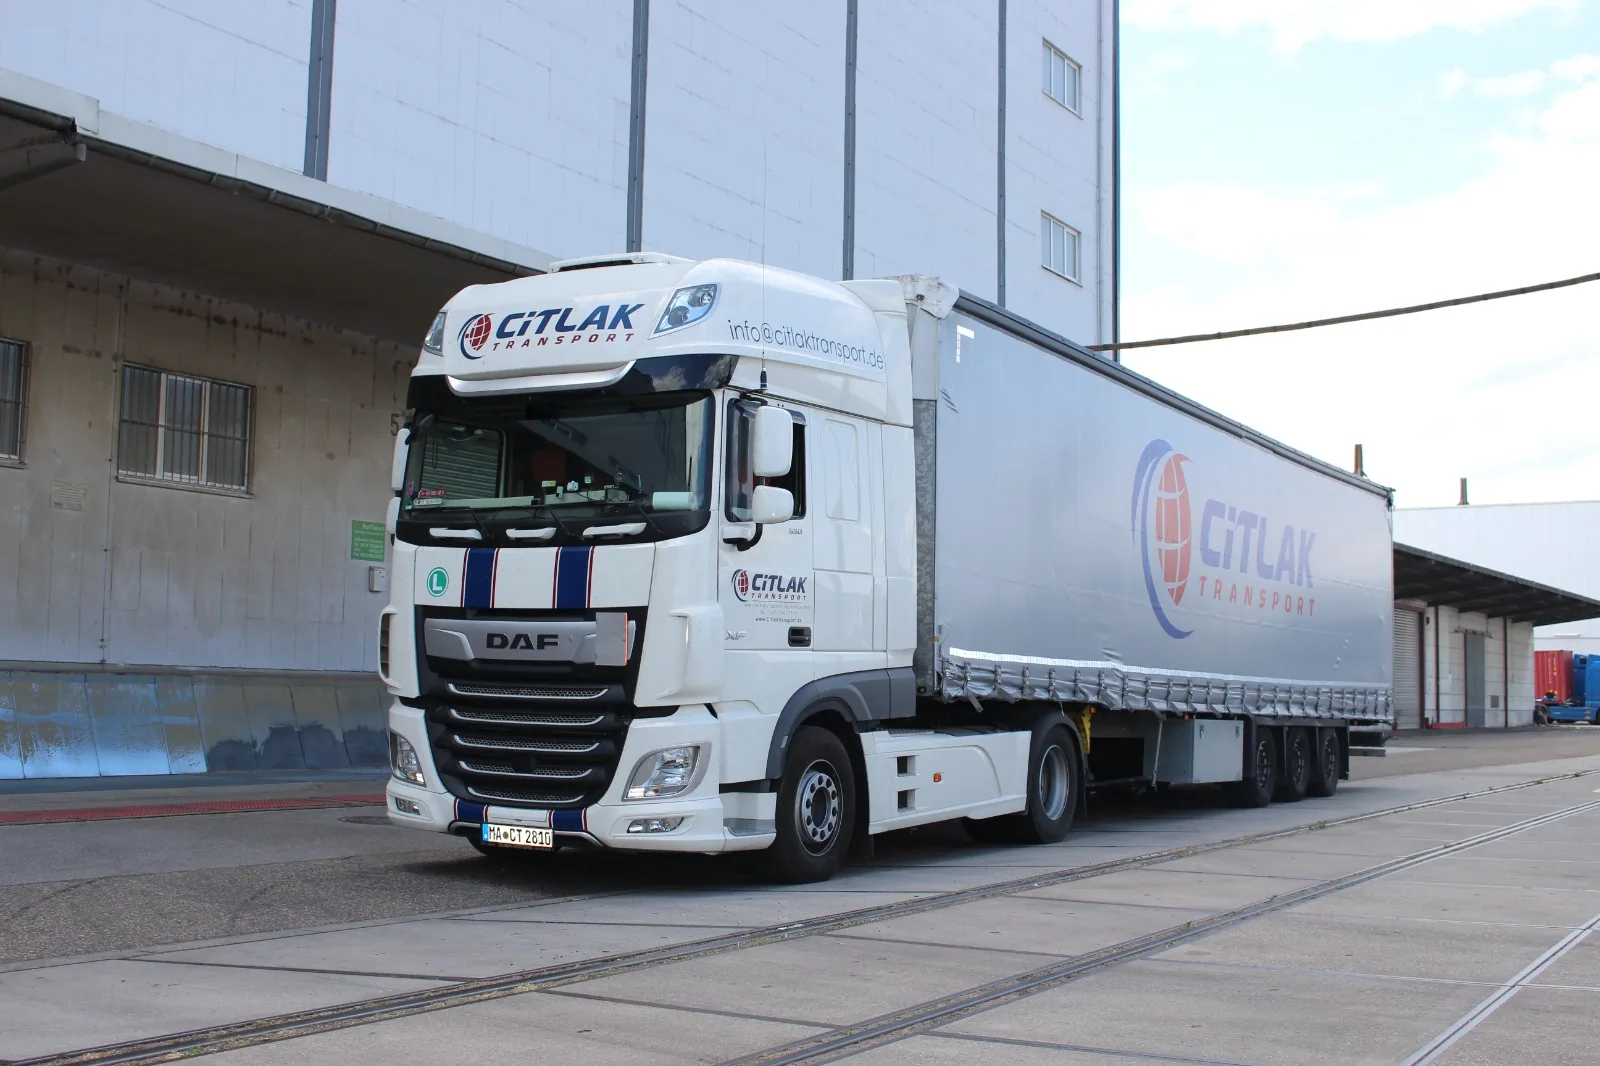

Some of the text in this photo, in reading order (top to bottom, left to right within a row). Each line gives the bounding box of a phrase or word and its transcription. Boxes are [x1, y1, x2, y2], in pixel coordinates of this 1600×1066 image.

[495, 303, 646, 339] CiTLAK
[492, 333, 634, 351] TRANSPORT
[727, 319, 884, 369] info@citlaktransport.de
[1200, 498, 1316, 589] CiTLAK
[432, 573, 443, 591] L
[752, 574, 807, 593] CiTLAK
[1199, 575, 1316, 617] TRANSPORT
[486, 633, 559, 650] DAF
[489, 826, 502, 841] MA
[509, 828, 522, 843] CT
[525, 830, 551, 846] 2810
